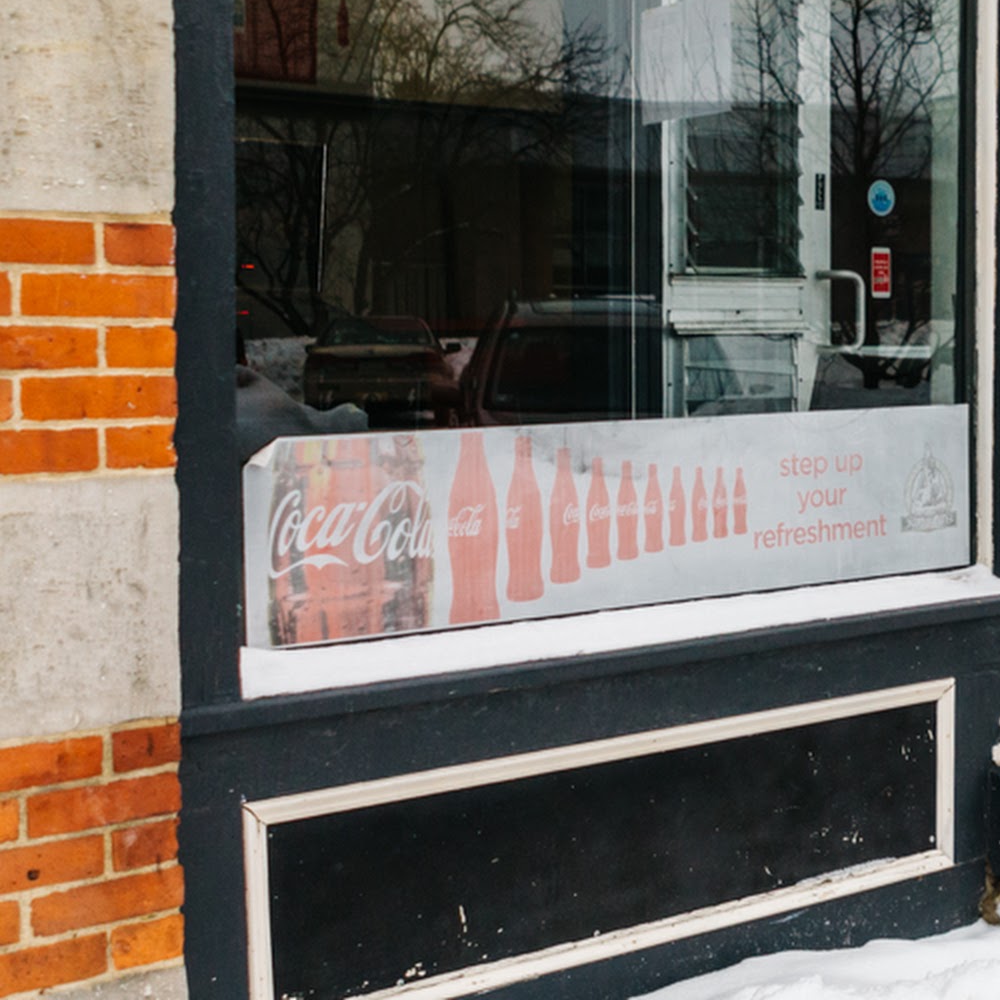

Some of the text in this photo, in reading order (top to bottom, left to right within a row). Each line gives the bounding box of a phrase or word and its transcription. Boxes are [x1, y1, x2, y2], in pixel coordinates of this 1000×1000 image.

[779, 452, 864, 479] step up
[796, 486, 848, 515] your
[752, 513, 888, 550] refreshment
